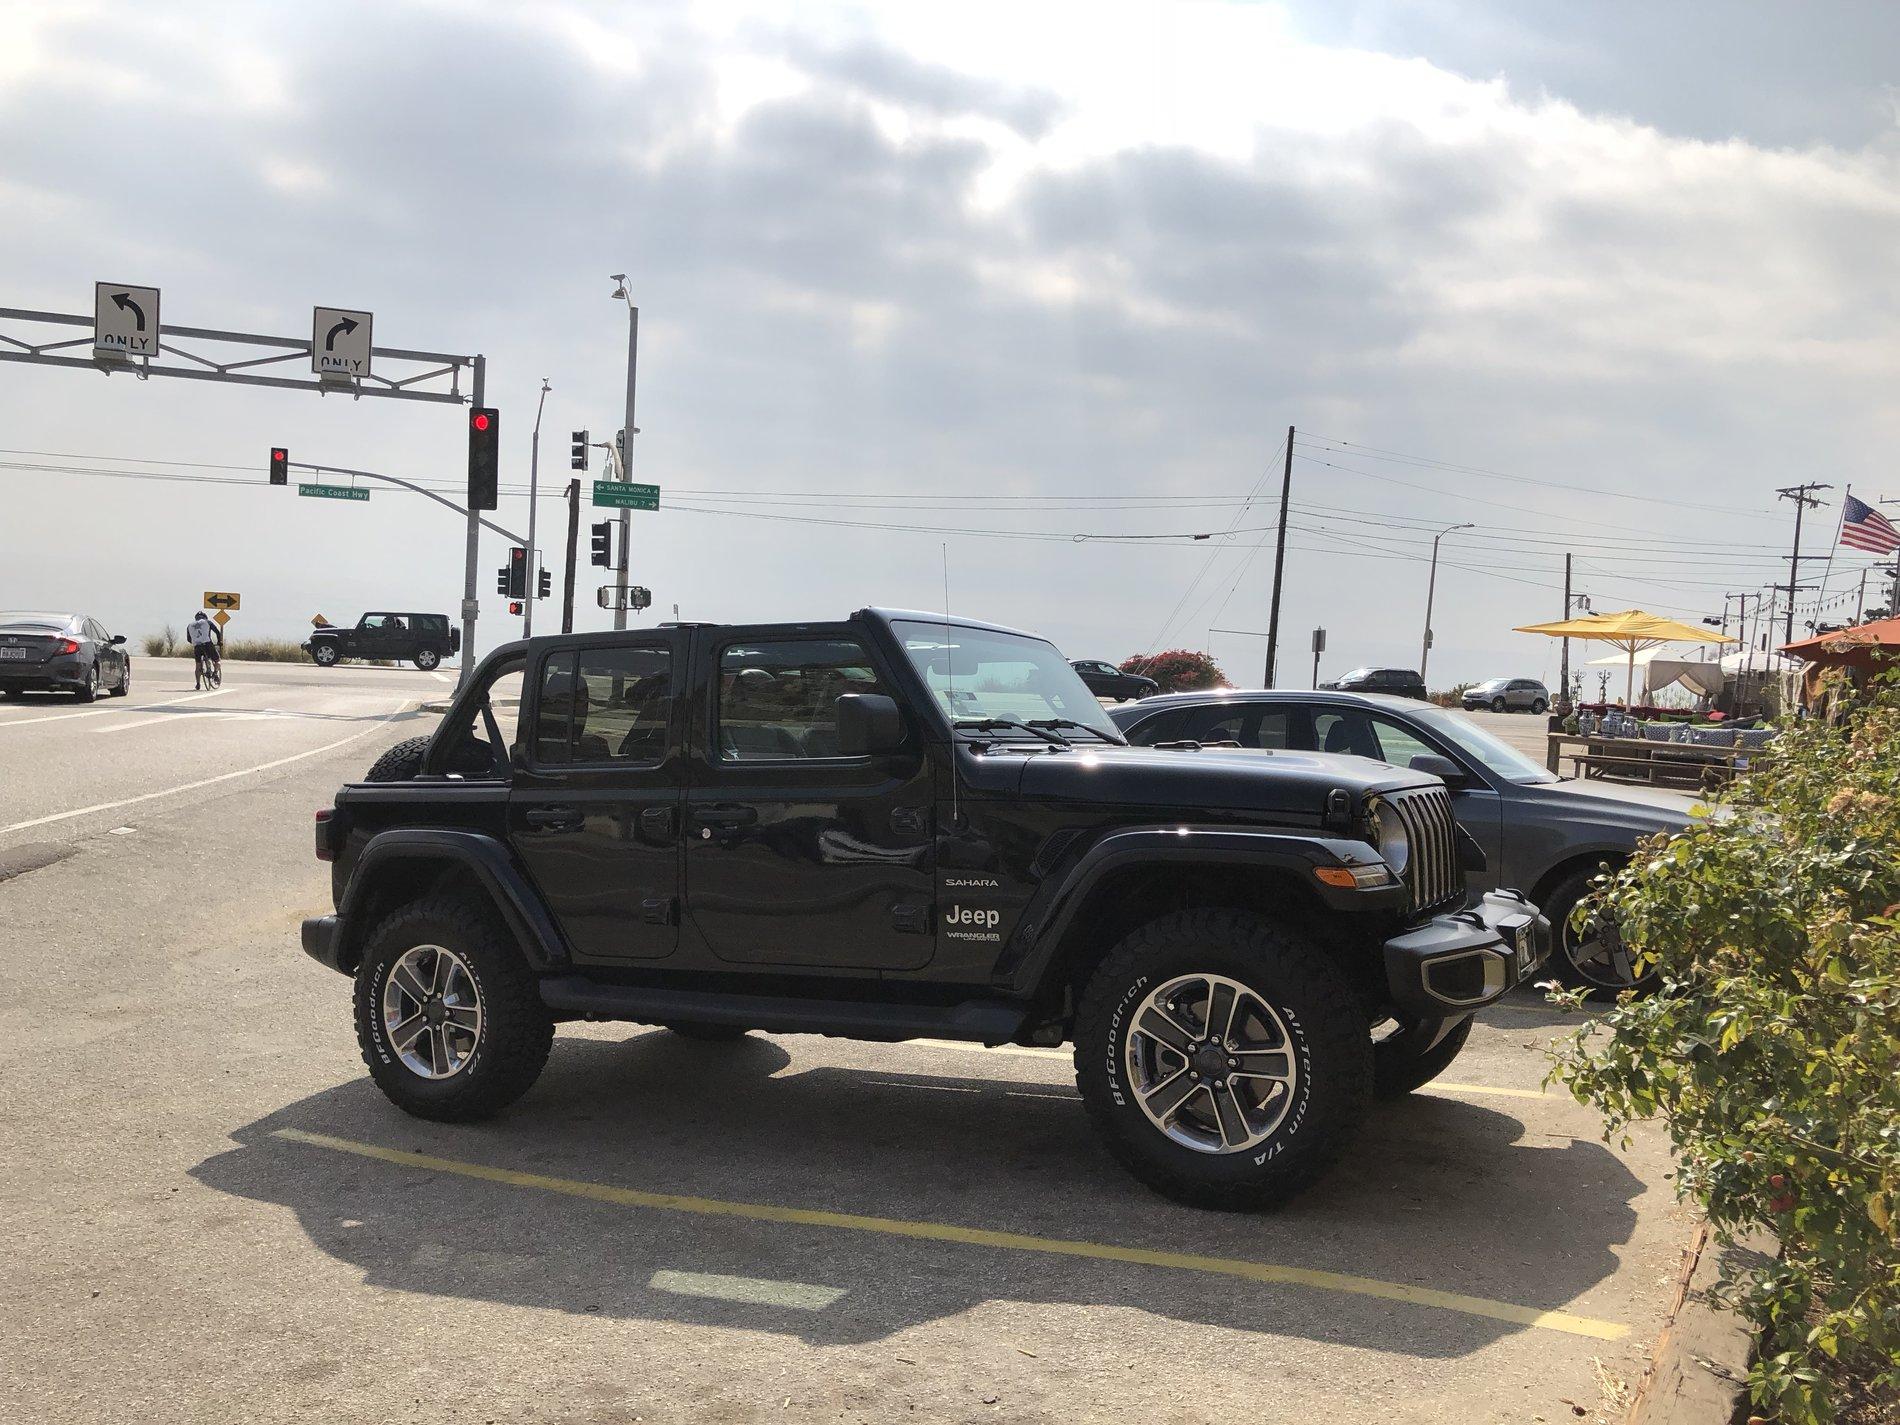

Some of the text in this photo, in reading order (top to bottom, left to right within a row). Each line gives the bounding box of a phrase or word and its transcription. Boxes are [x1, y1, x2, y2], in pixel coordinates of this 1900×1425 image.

[104, 334, 150, 350] ONLY
[300, 486, 368, 500] Pacific Coast Hwy
[945, 879, 999, 887] SAHARA
[946, 905, 1000, 929] Jeep
[369, 961, 391, 1064] BFGoodrich
[1106, 975, 1148, 1106] BFGoodrich
[1254, 1006, 1310, 1166] All-Terrain T/A
